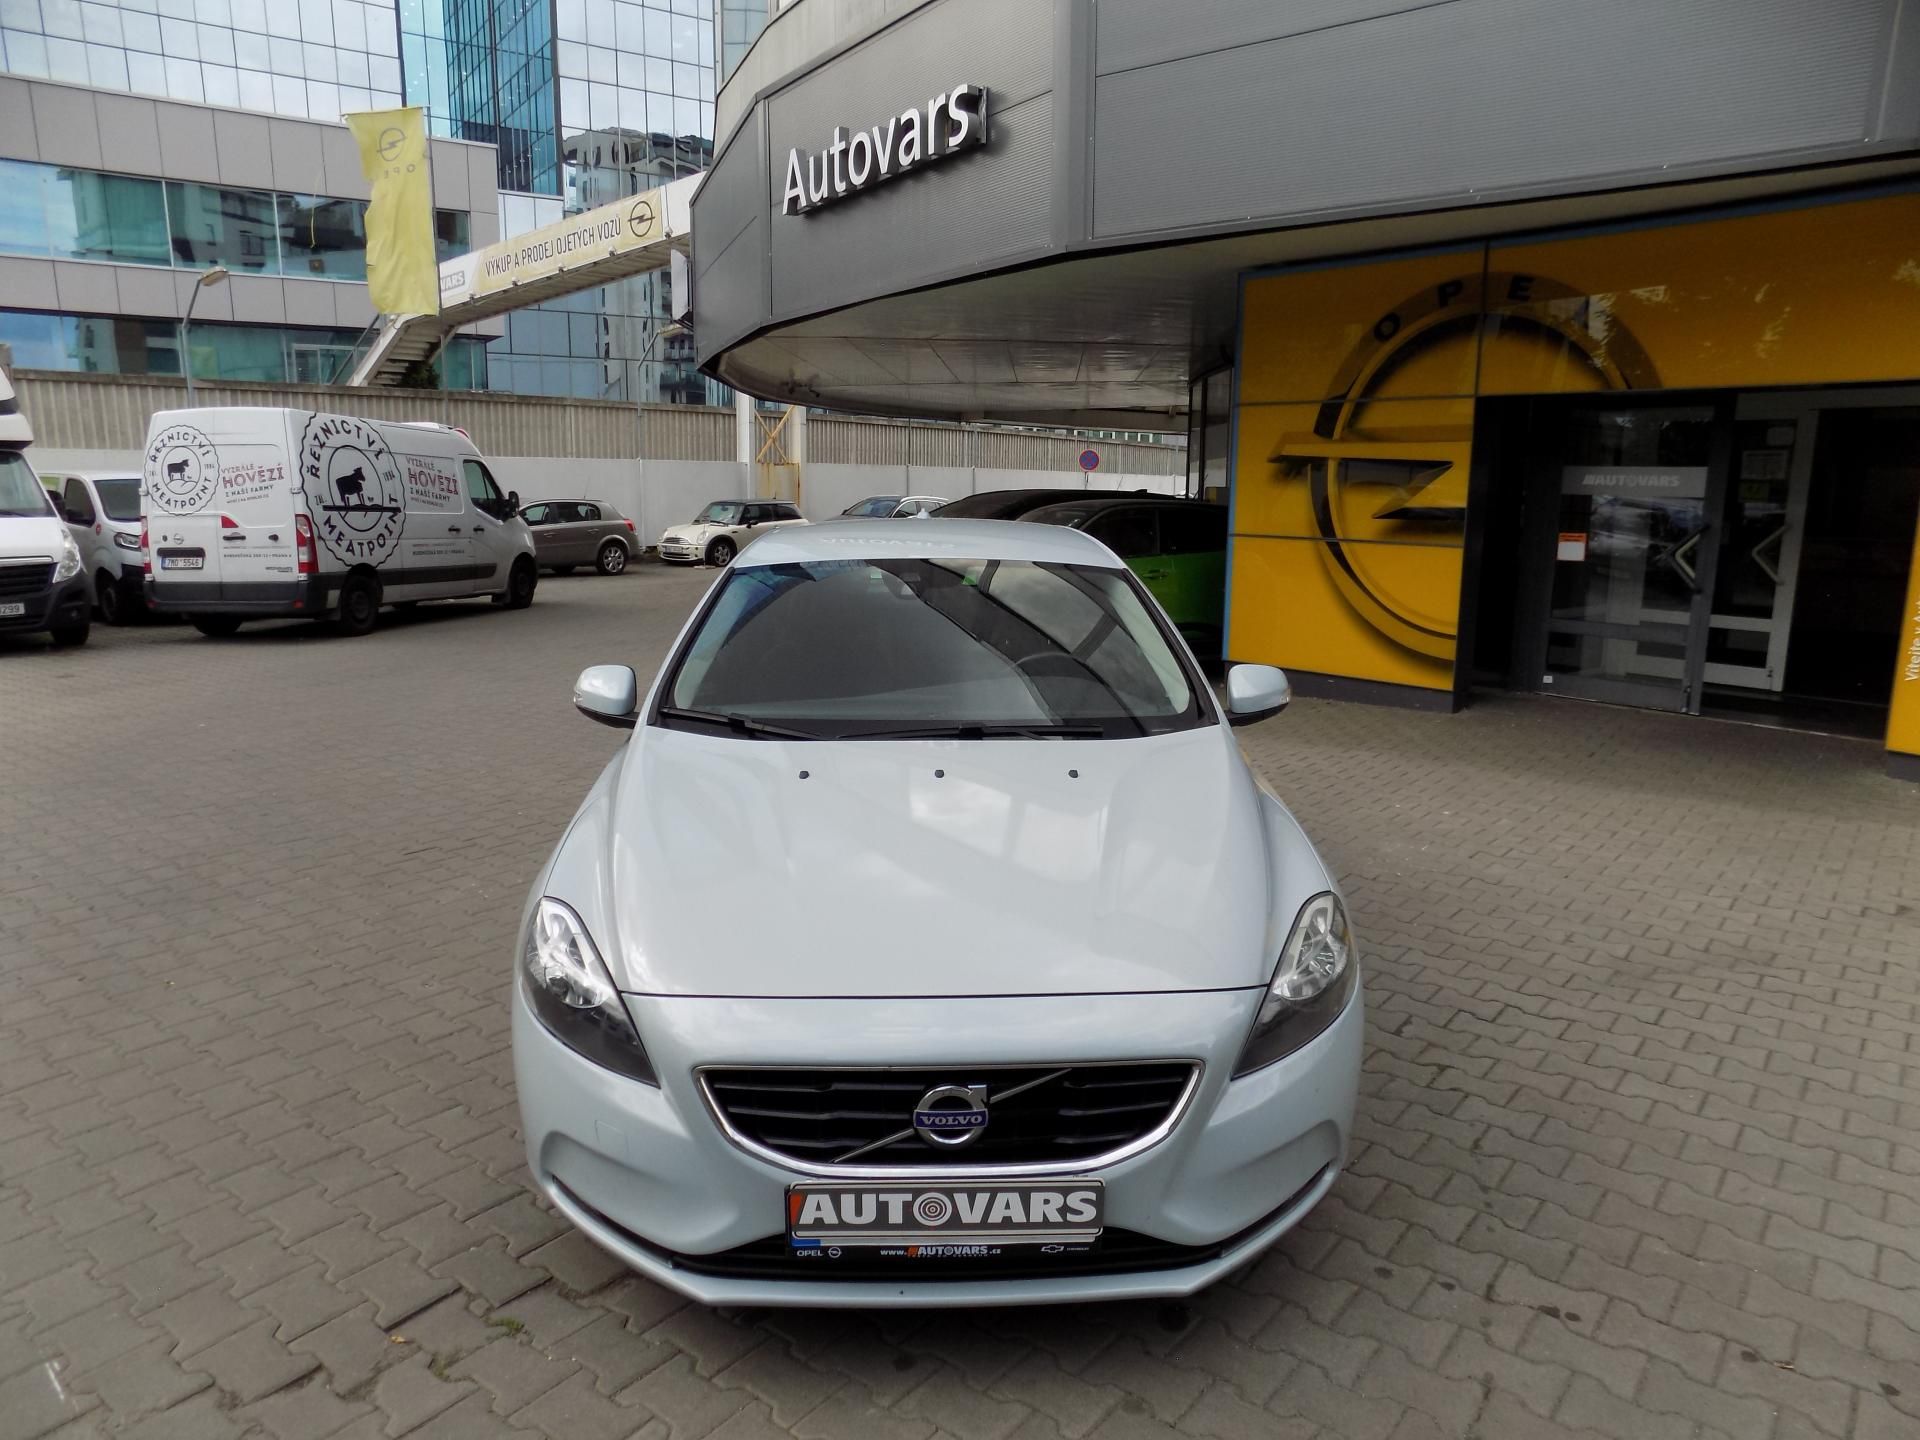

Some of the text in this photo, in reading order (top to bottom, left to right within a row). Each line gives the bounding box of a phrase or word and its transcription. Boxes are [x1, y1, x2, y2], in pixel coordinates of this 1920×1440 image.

[782, 83, 978, 216] Autovars
[485, 215, 622, 278] VÝKUP A PRODEJ OJETÝCH VOZŮ
[306, 419, 386, 480] ŘEZNICTVÍ
[152, 477, 213, 509] MEATPOINT
[222, 463, 284, 489] HOVĚZÍ
[408, 467, 458, 495] HOVĚZÍ
[323, 493, 399, 558] MEATPOINT
[919, 1114, 983, 1125] VOLVO
[799, 1190, 1097, 1226] AUTOVARS
[796, 1249, 823, 1257] OPEL
